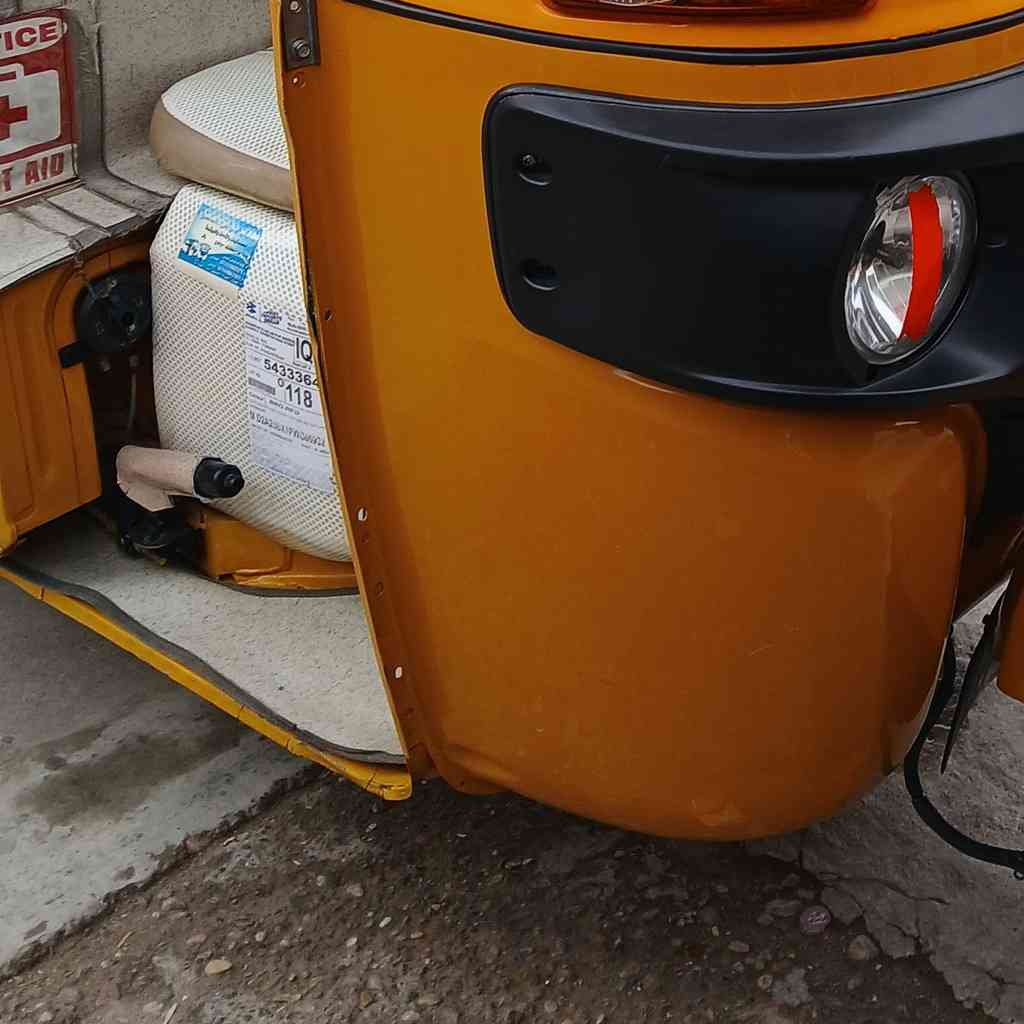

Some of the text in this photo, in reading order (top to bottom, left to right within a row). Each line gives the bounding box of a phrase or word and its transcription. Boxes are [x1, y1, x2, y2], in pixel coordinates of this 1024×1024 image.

[25, 152, 65, 187] AID
[295, 337, 313, 364] IQ
[285, 383, 313, 408] 118
